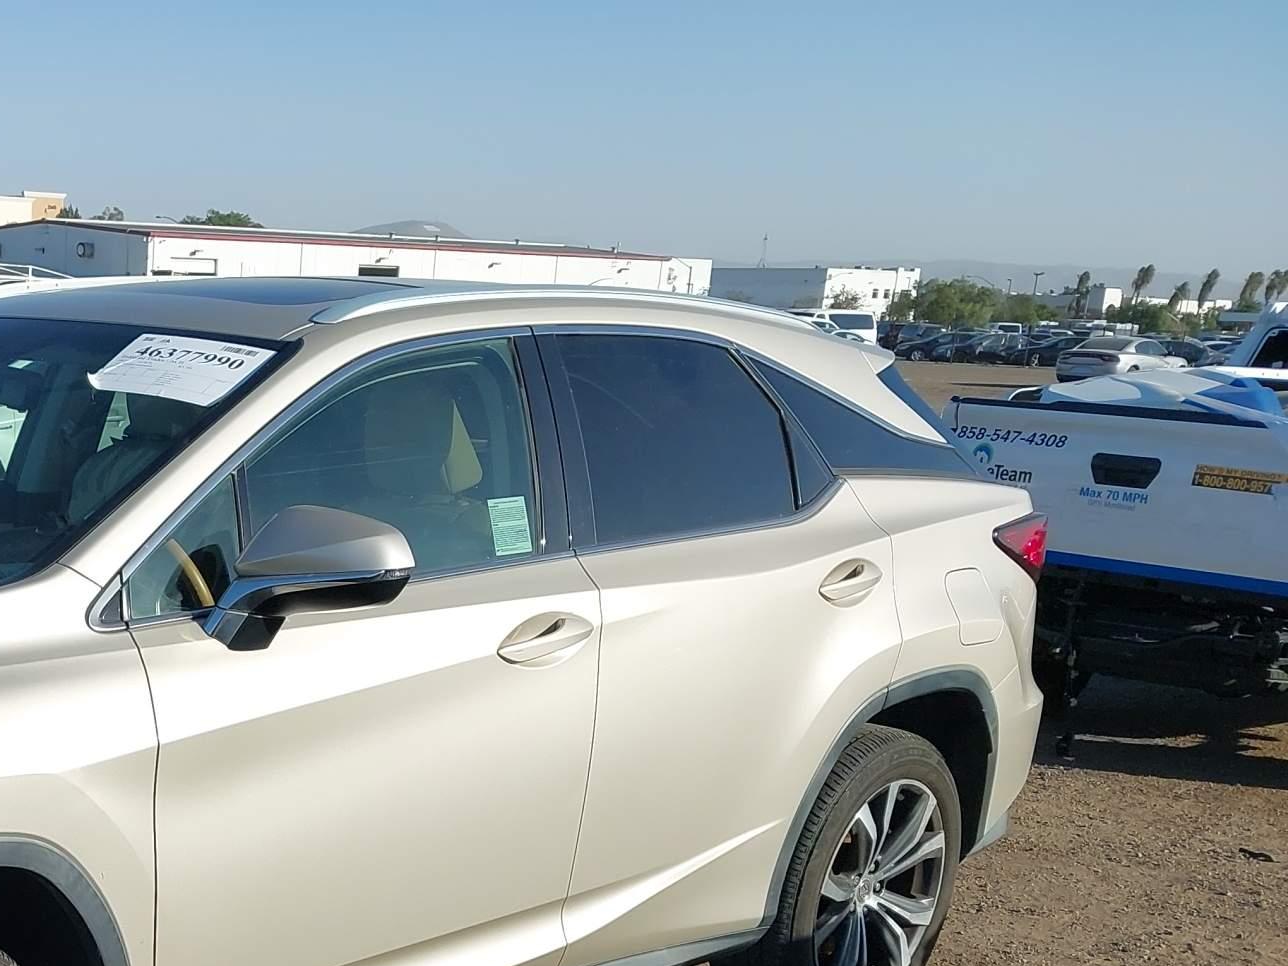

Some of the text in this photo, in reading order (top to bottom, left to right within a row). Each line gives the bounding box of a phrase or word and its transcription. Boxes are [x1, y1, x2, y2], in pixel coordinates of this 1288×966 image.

[135, 345, 245, 370] 46377990
[957, 425, 1068, 448] 858-547-4308
[1079, 487, 1149, 504] Max 70 MPH
